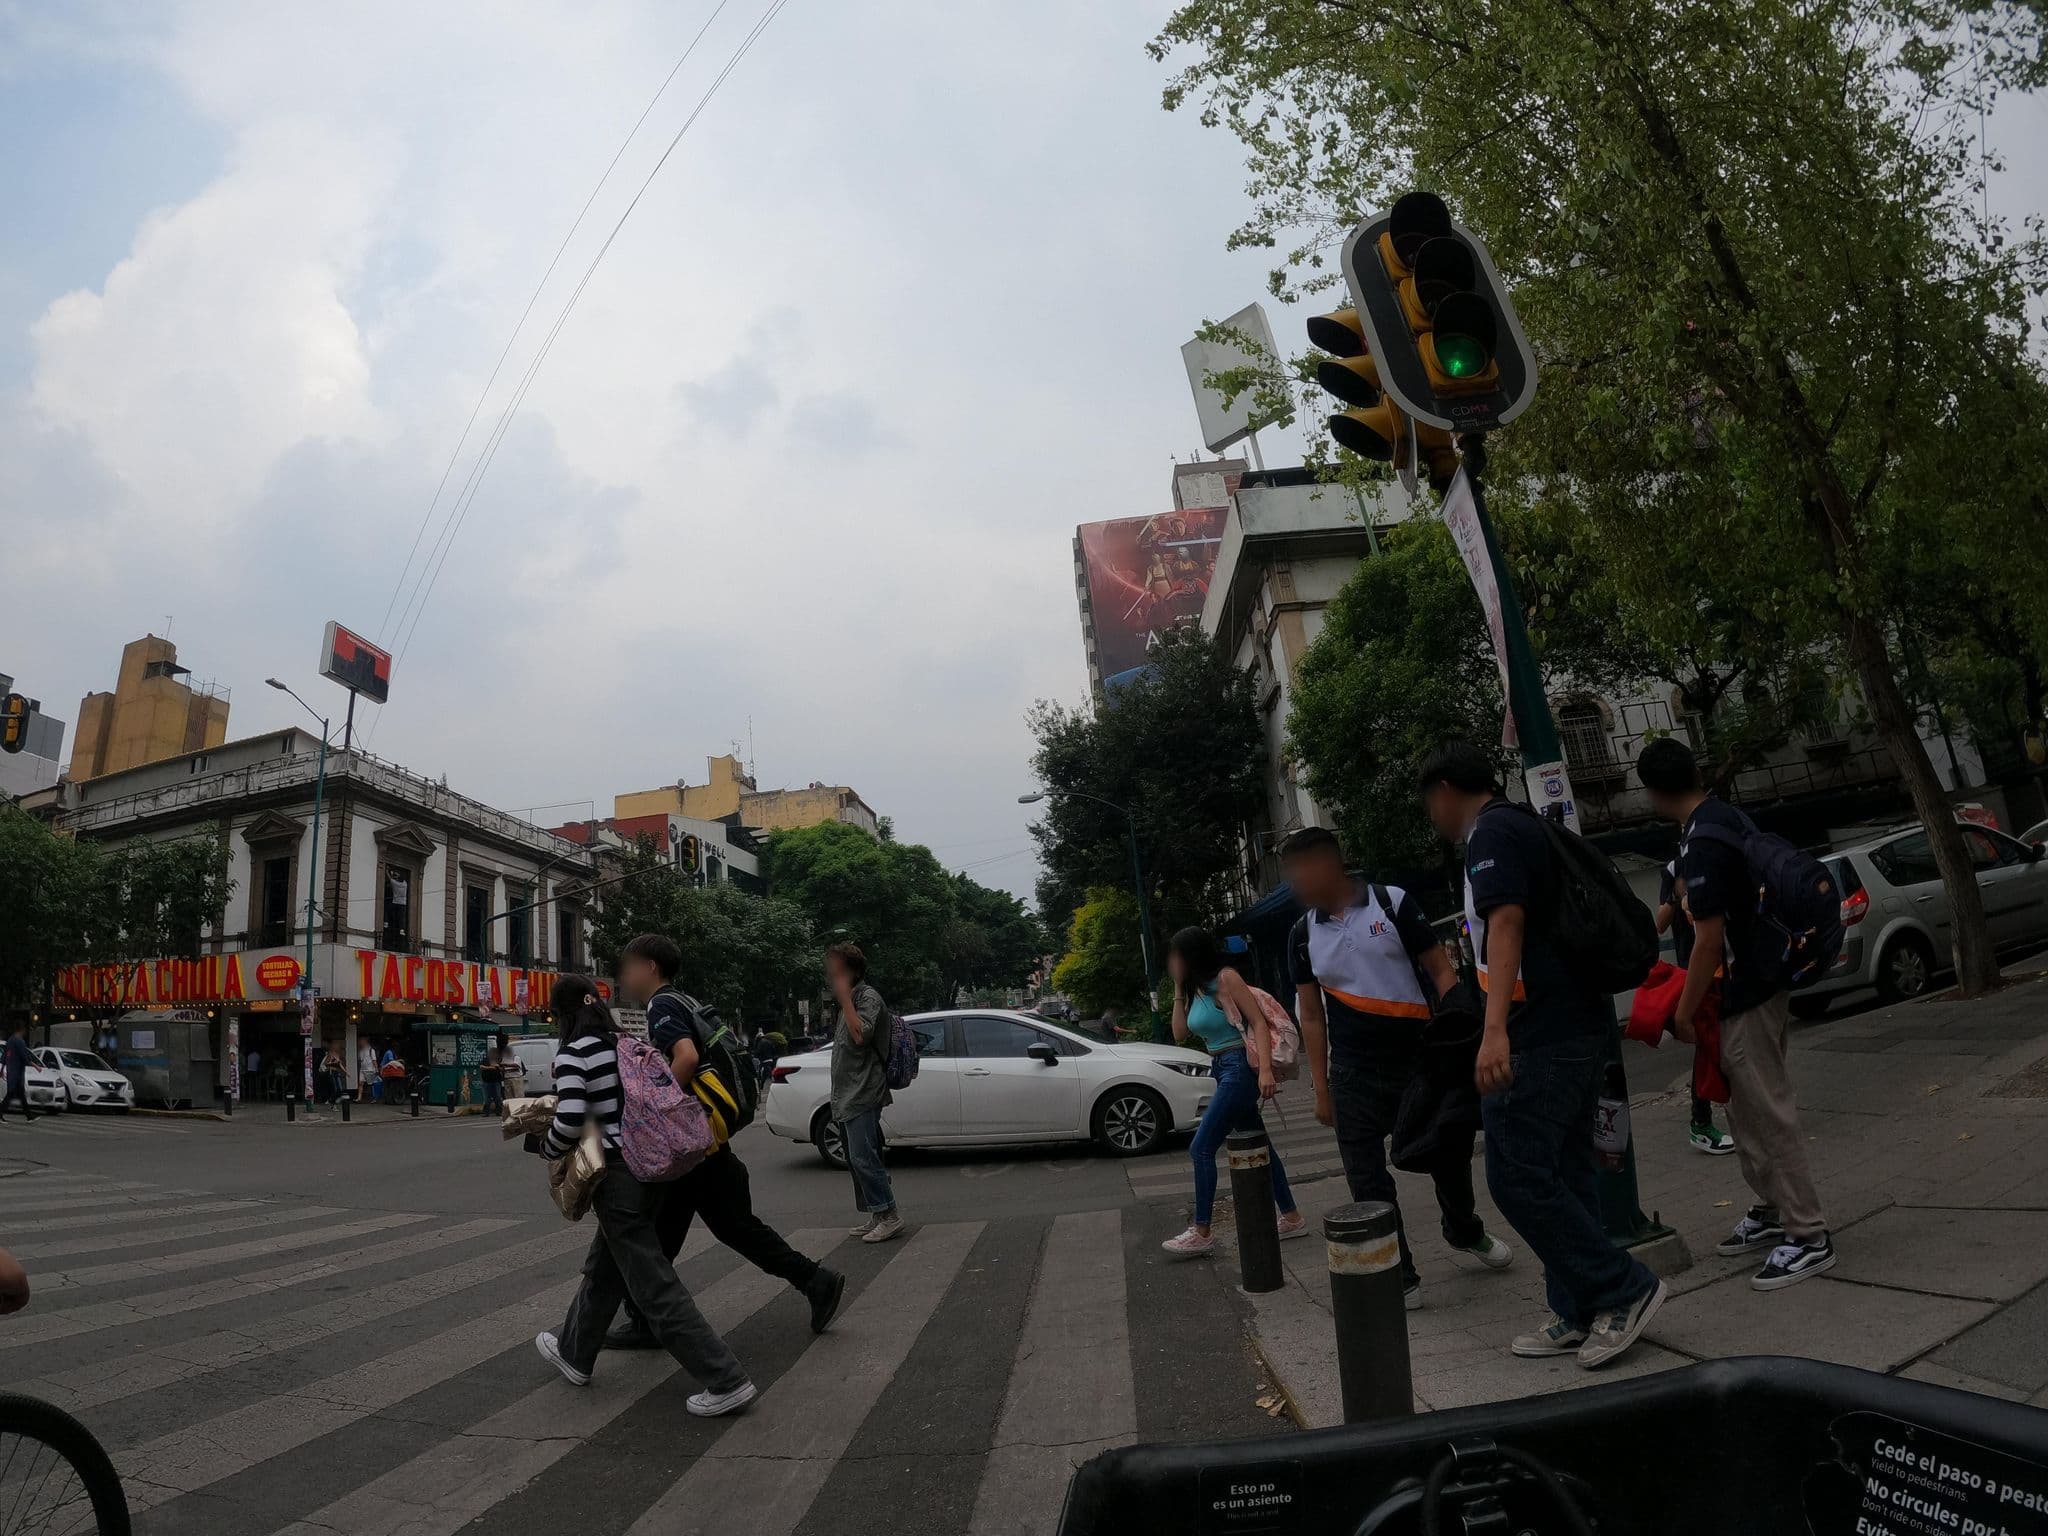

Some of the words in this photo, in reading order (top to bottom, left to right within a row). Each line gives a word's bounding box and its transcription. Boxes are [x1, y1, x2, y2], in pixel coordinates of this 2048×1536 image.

[1452, 404, 1489, 417] CDMX
[55, 964, 119, 1003] ACOS
[156, 952, 246, 1001] CHULA
[262, 960, 294, 970] TORTILLAS
[263, 969, 287, 978] HECHAS
[355, 950, 464, 1003] TACOS
[1871, 1457, 1894, 1474] Yield
[1896, 1467, 1906, 1479] to
[1907, 1472, 1969, 1503] pedestrians.
[1874, 1438, 1916, 1466] Cede
[1919, 1455, 1936, 1474] el
[1938, 1463, 1982, 1489] paso
[1985, 1479, 1997, 1495] a
[1213, 1500, 1226, 1510] es
[1229, 1499, 1245, 1509] un
[1247, 1493, 1292, 1507] asiento
[1230, 1484, 1257, 1495] Esto
[1259, 1482, 1275, 1493] no
[1862, 1496, 1889, 1517] Don't
[1889, 1510, 1909, 1525] ride
[1910, 1518, 1923, 1530] on
[1925, 1524, 1951, 1536] side
[1867, 1477, 1889, 1499] No
[1892, 1489, 1960, 1528] circules
[1961, 1517, 1996, 1536] por
[1856, 1516, 1897, 1536] Evit
